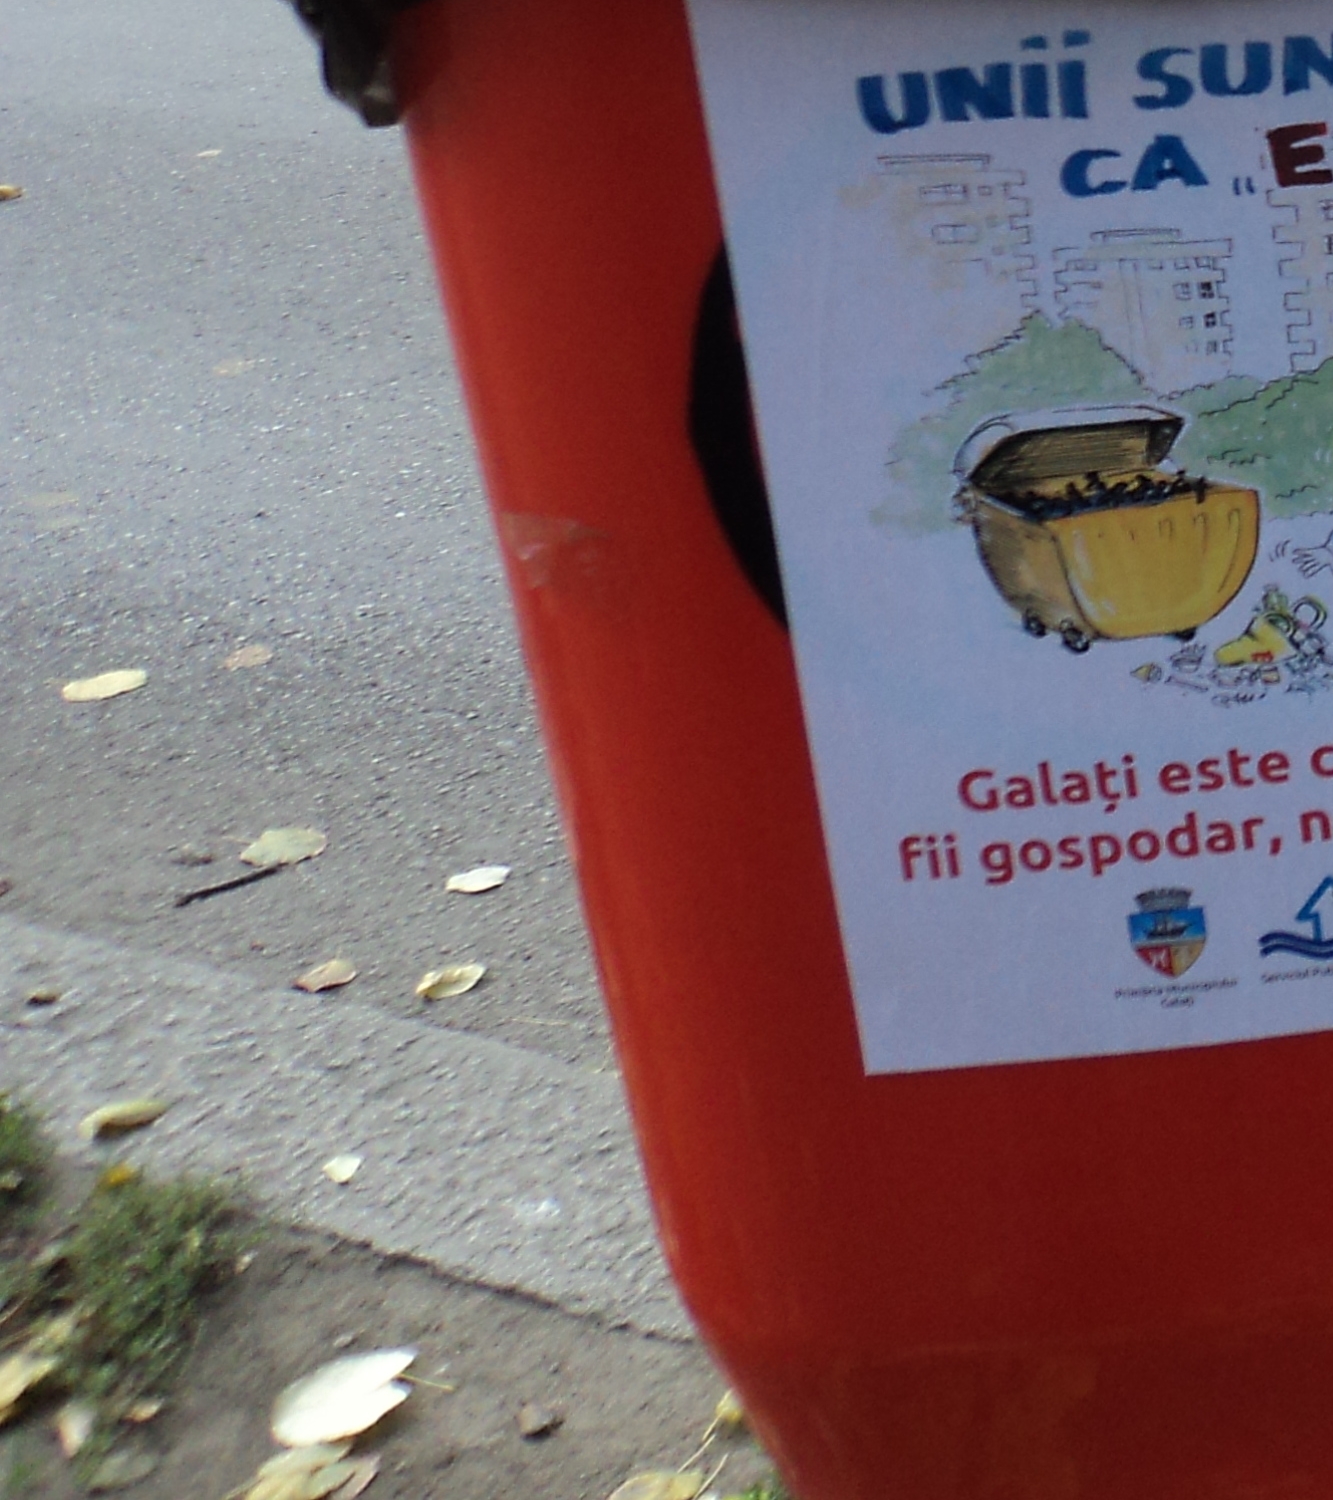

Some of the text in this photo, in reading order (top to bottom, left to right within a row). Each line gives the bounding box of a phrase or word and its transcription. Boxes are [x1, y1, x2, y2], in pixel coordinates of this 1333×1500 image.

[1059, 133, 1210, 198] CA
[1158, 748, 1291, 795] este
[899, 832, 962, 881] fii
[979, 810, 1283, 886] gospodar,
